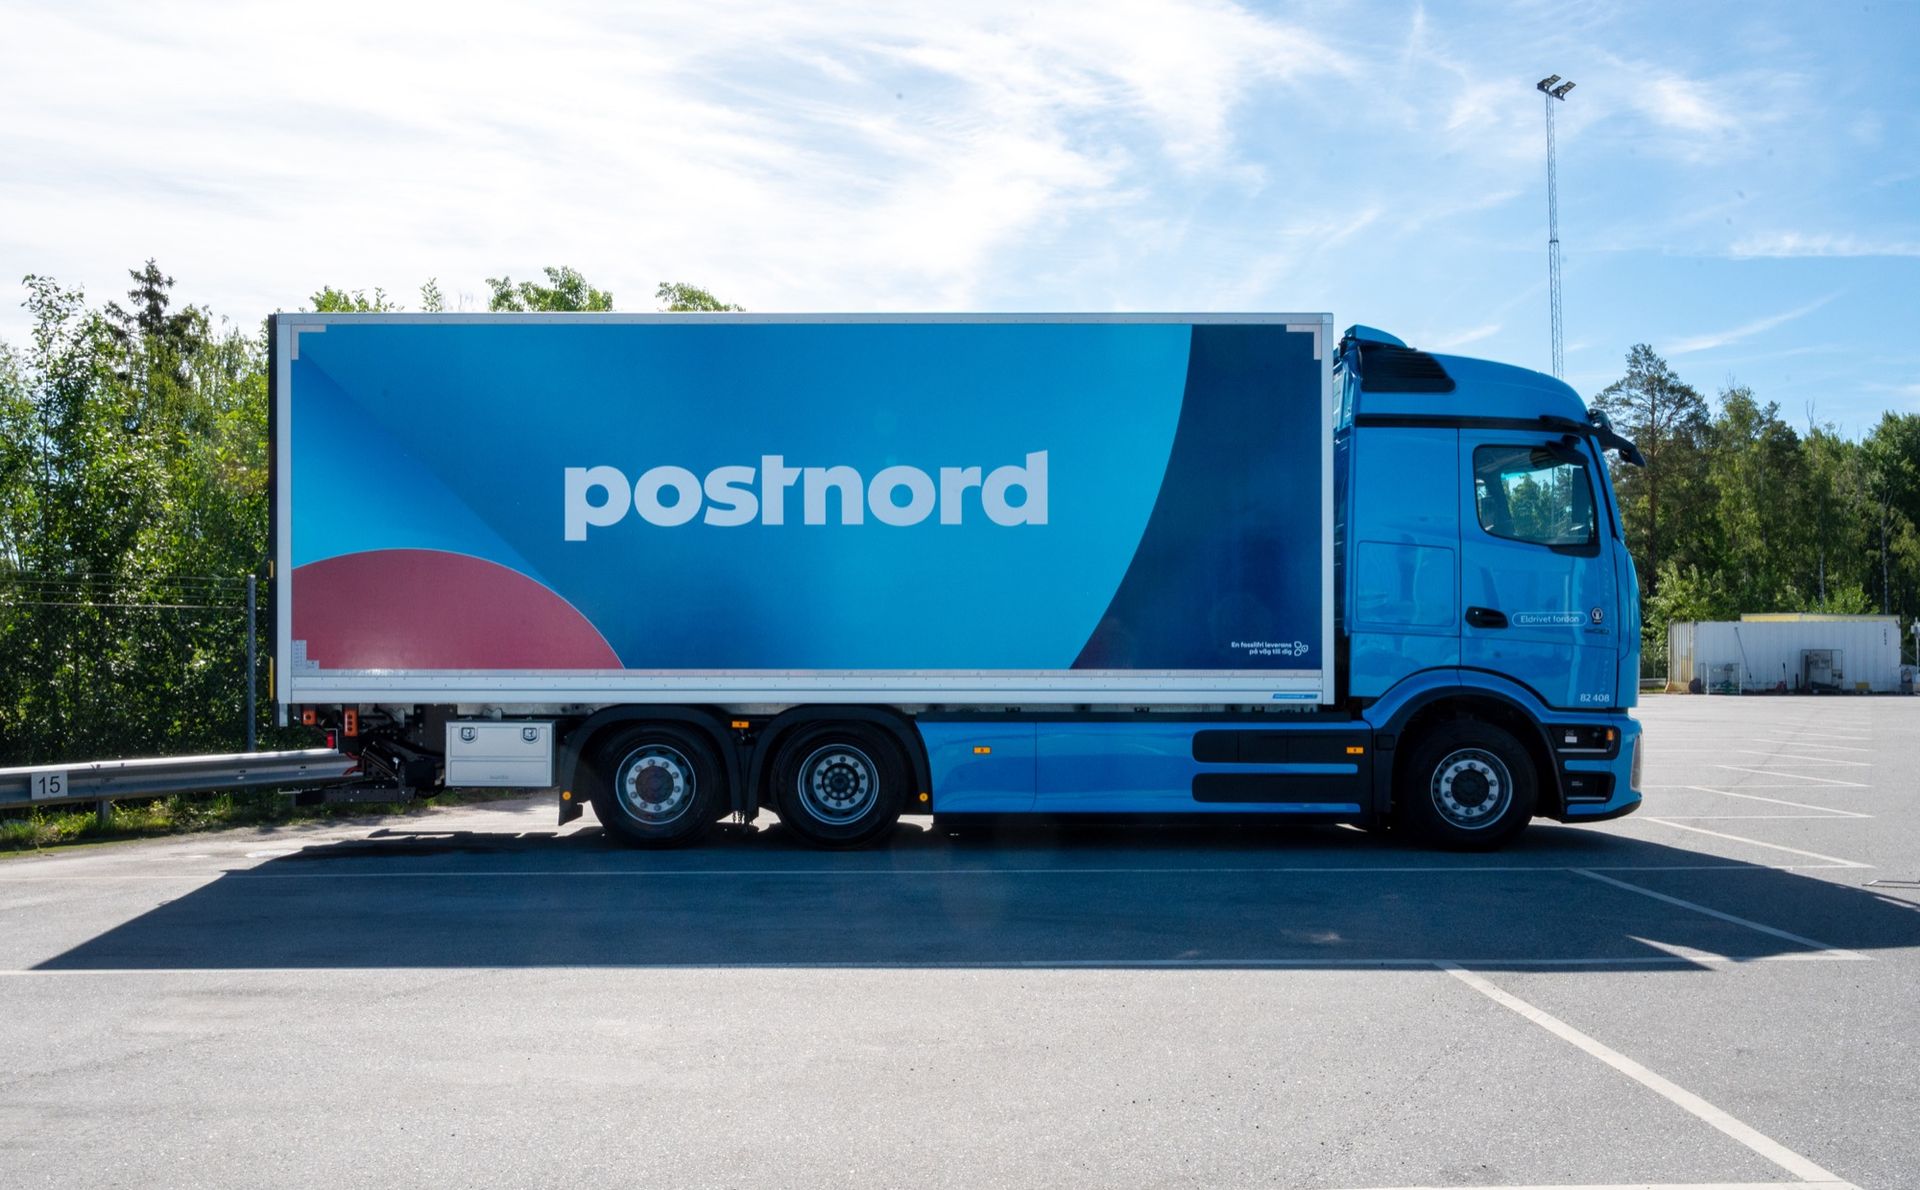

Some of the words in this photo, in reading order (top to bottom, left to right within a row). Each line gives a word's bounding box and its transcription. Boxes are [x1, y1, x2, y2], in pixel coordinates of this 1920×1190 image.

[564, 450, 1048, 541] postnord
[1520, 615, 1551, 623] Eldrivet
[1553, 615, 1580, 623] fordon
[1282, 648, 1292, 656] dig
[1580, 693, 1591, 702] 82
[1593, 693, 1610, 702] 408
[39, 776, 61, 794] 15
